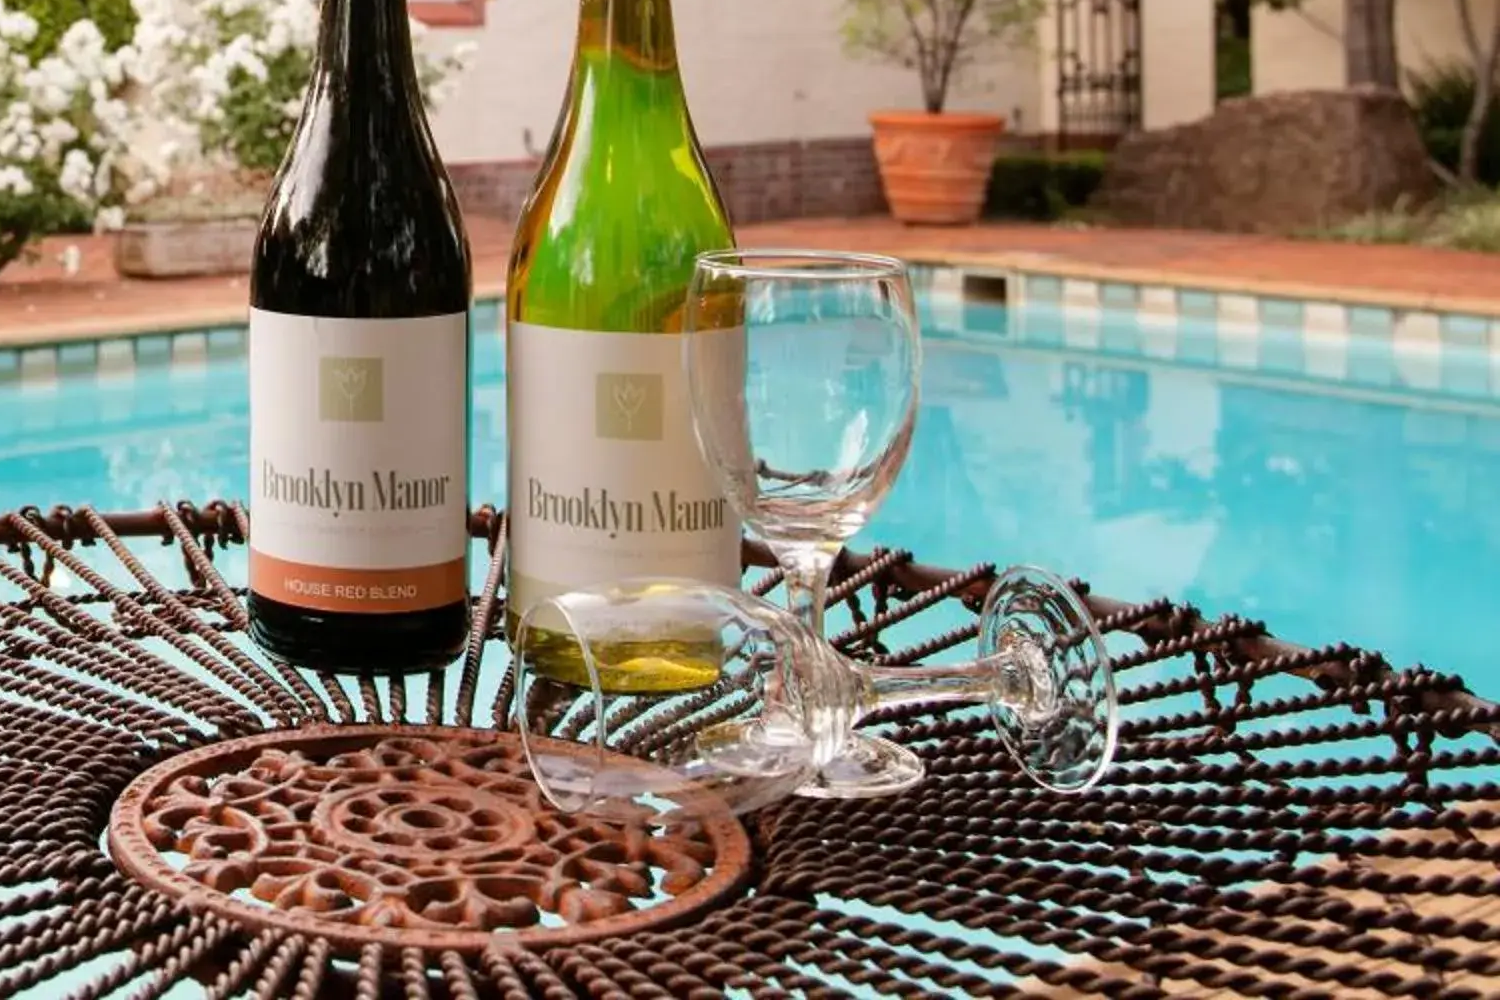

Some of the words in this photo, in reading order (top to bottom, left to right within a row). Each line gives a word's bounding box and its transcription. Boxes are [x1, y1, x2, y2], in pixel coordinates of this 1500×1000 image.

[262, 459, 365, 517] Brooklyn
[372, 470, 450, 511] Manor
[529, 477, 643, 538] Brooklyn
[651, 490, 727, 532] Manor
[284, 576, 332, 597] HOUSE
[335, 585, 366, 599] RED
[370, 584, 417, 599] BLEND
